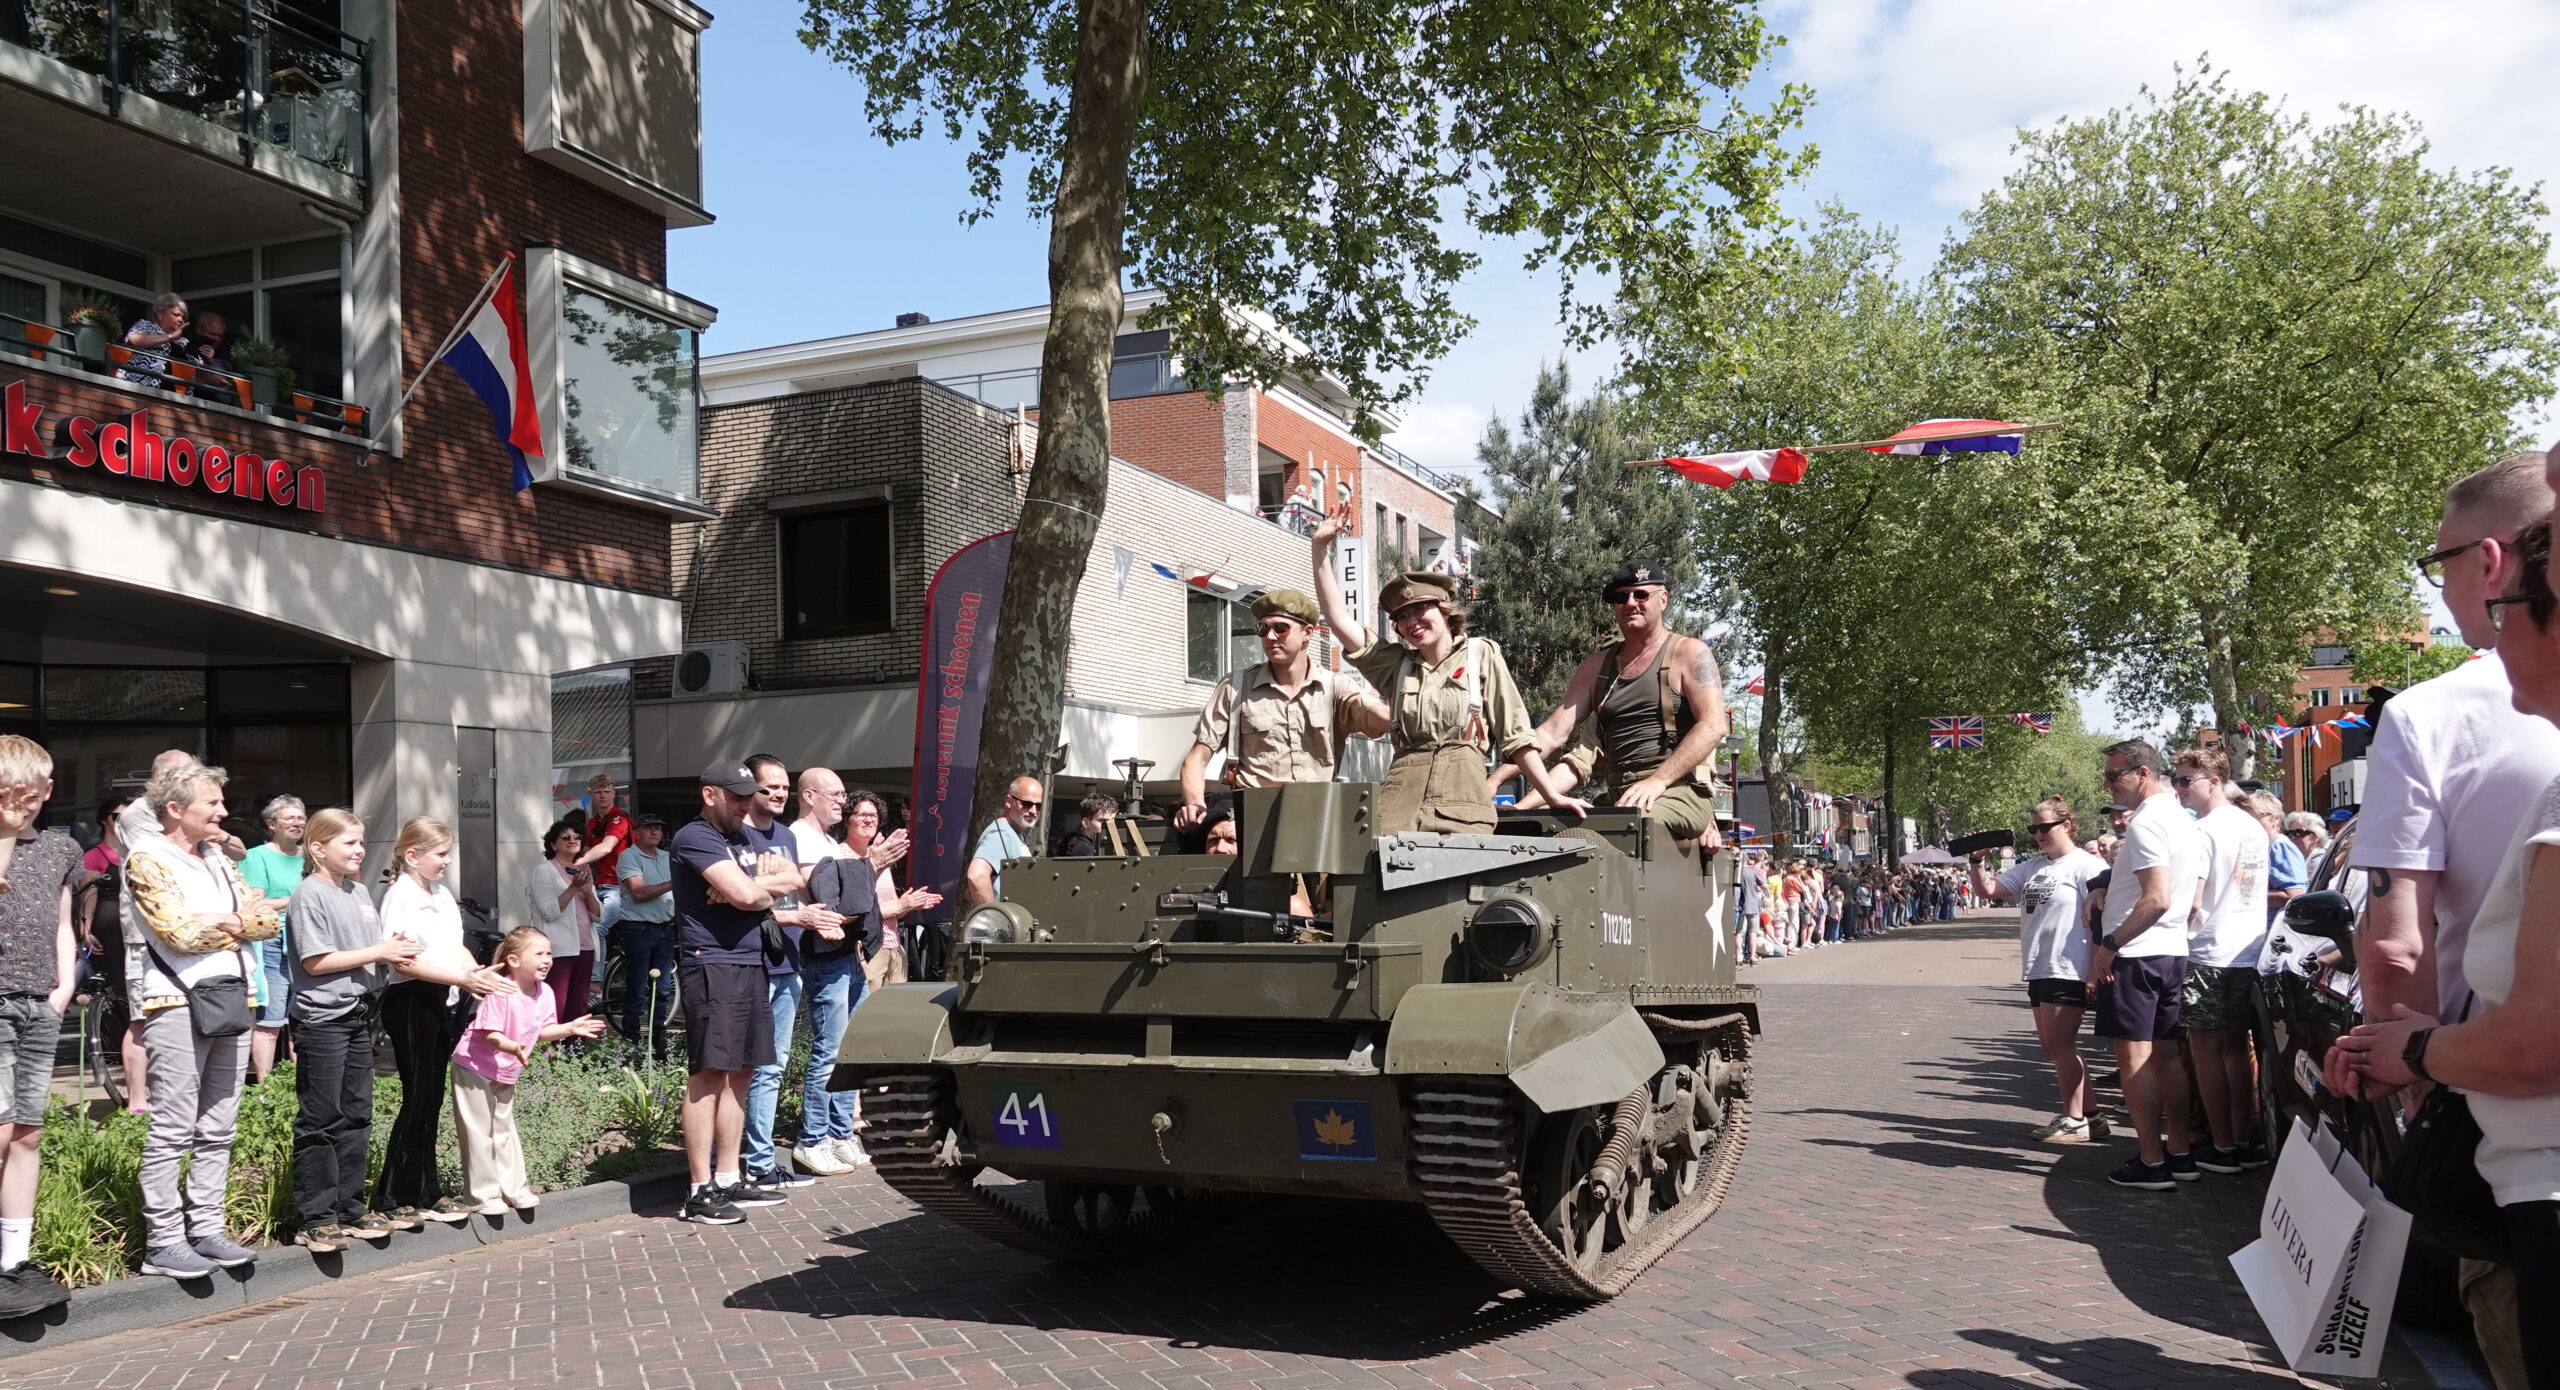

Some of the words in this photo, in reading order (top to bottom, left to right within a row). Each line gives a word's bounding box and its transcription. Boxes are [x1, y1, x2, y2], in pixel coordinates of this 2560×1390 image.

[66, 408, 326, 513] schoenen
[939, 592, 981, 700] schoenen
[1602, 912, 1632, 946] T112703
[999, 1092, 1051, 1137] 41
[2270, 1197, 2314, 1288] LIVERA
[2339, 1296, 2370, 1359] JEZELF
